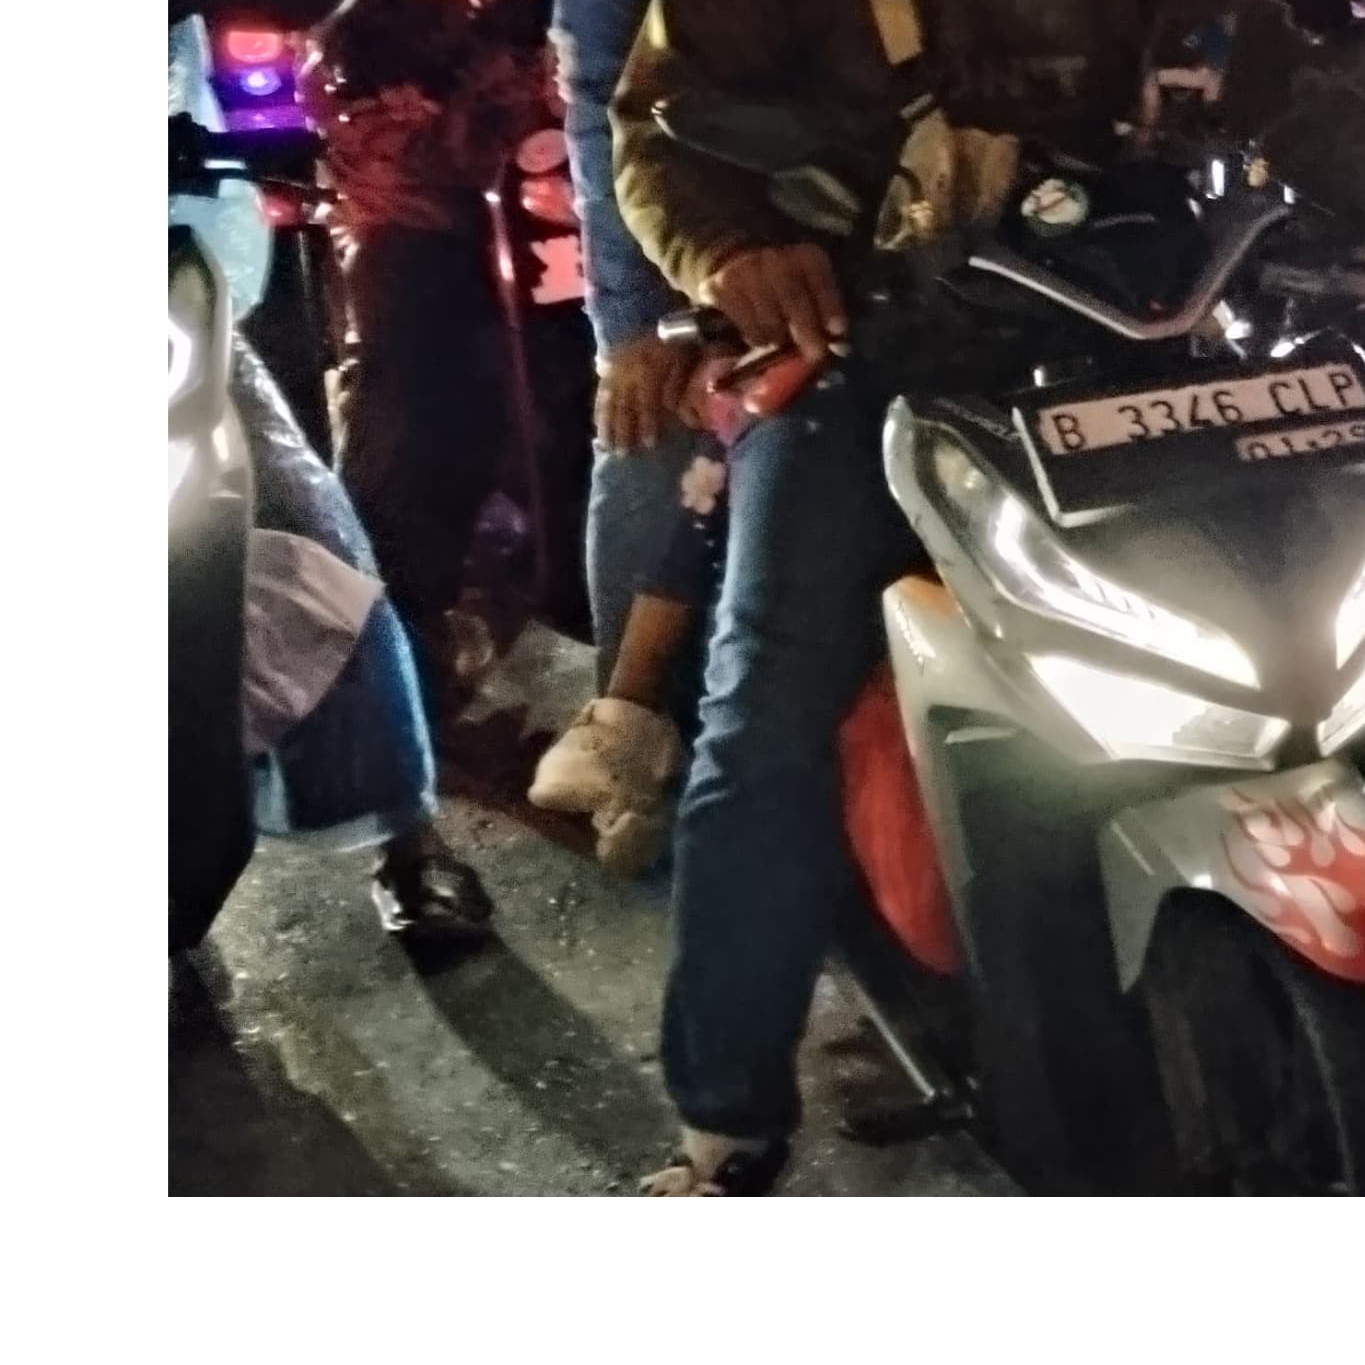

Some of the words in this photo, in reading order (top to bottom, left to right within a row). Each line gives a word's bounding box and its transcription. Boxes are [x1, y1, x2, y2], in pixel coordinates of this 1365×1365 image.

[1051, 413, 1086, 452] B
[1117, 390, 1244, 442] 3346
[1268, 371, 1354, 417] CLP
